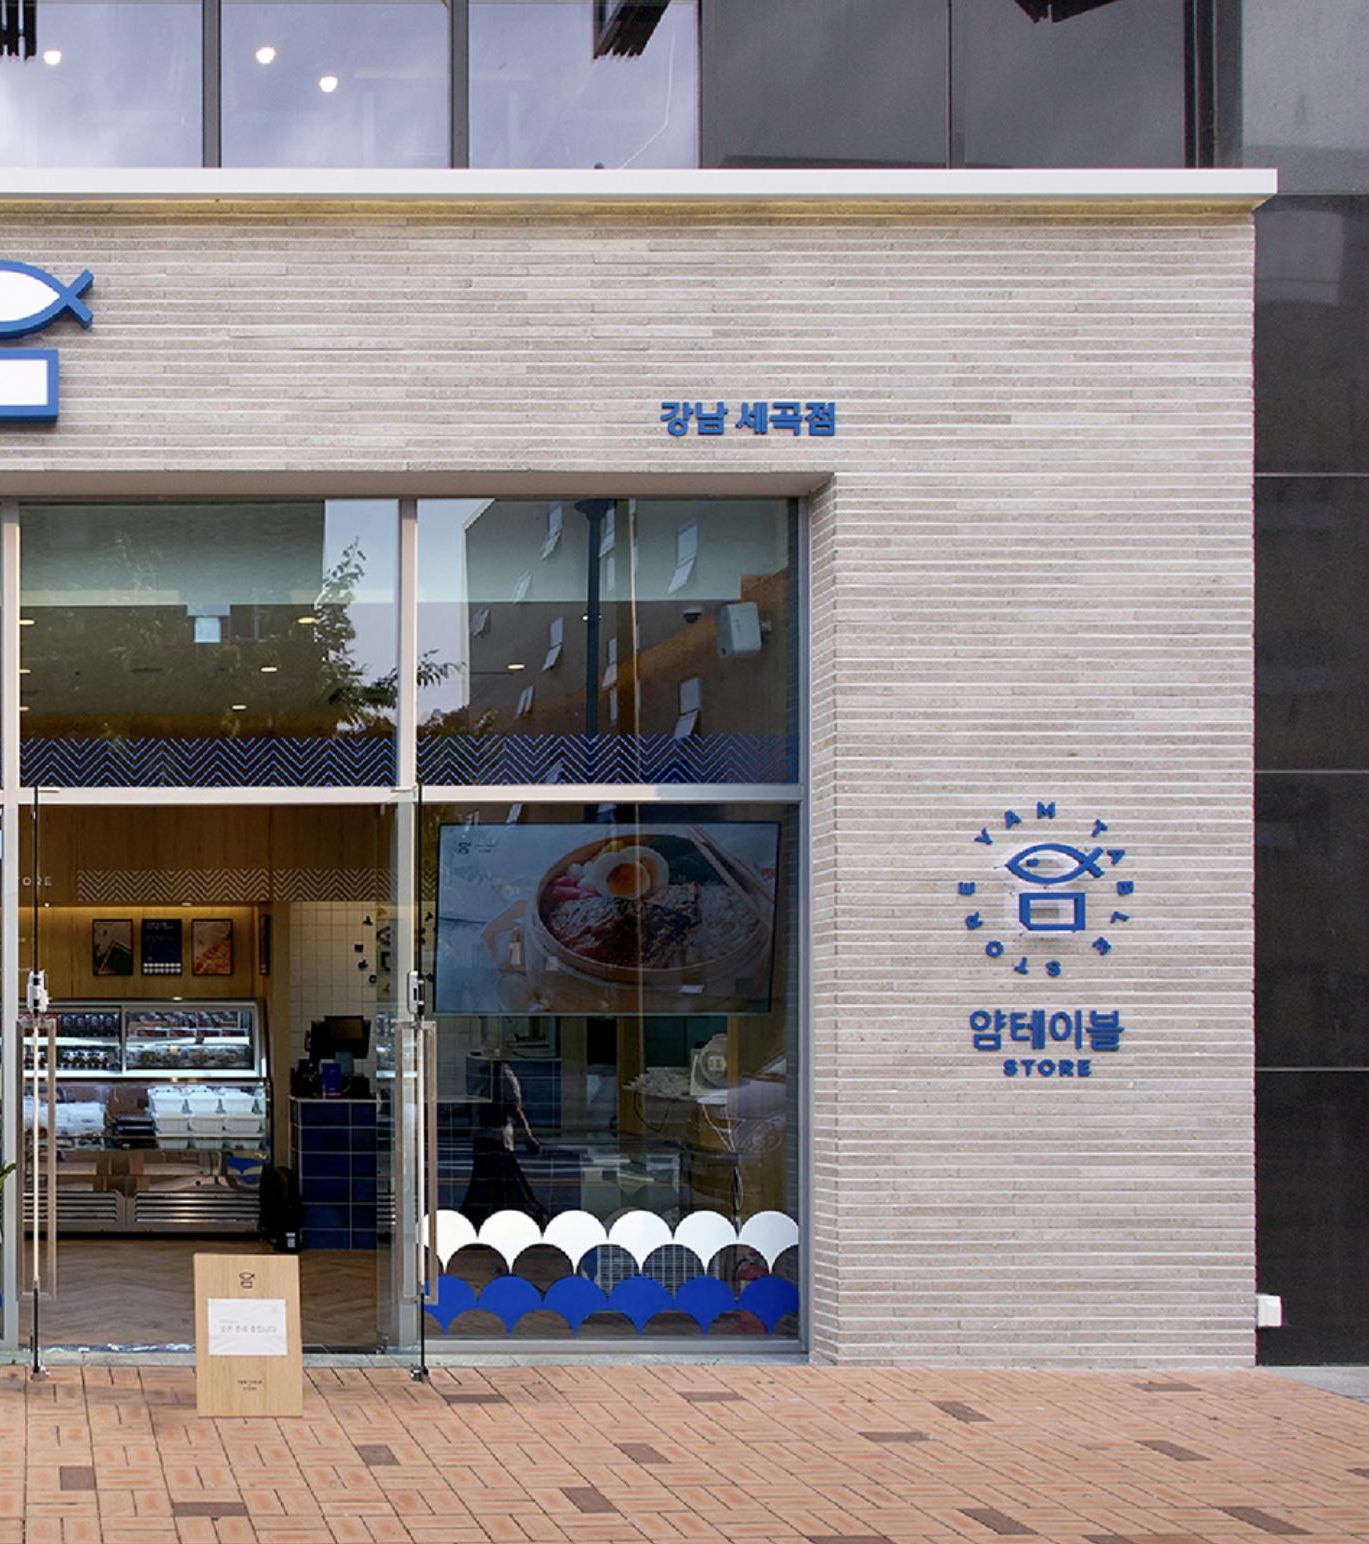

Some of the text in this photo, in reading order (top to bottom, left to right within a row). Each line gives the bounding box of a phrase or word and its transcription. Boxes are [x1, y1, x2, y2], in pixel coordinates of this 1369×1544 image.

[660, 401, 836, 436] 강남 세곡점
[957, 801, 1135, 978] YAM TABLE STORE
[969, 1009, 1125, 1051] 얌테이블
[1002, 1058, 1092, 1077] STORE
